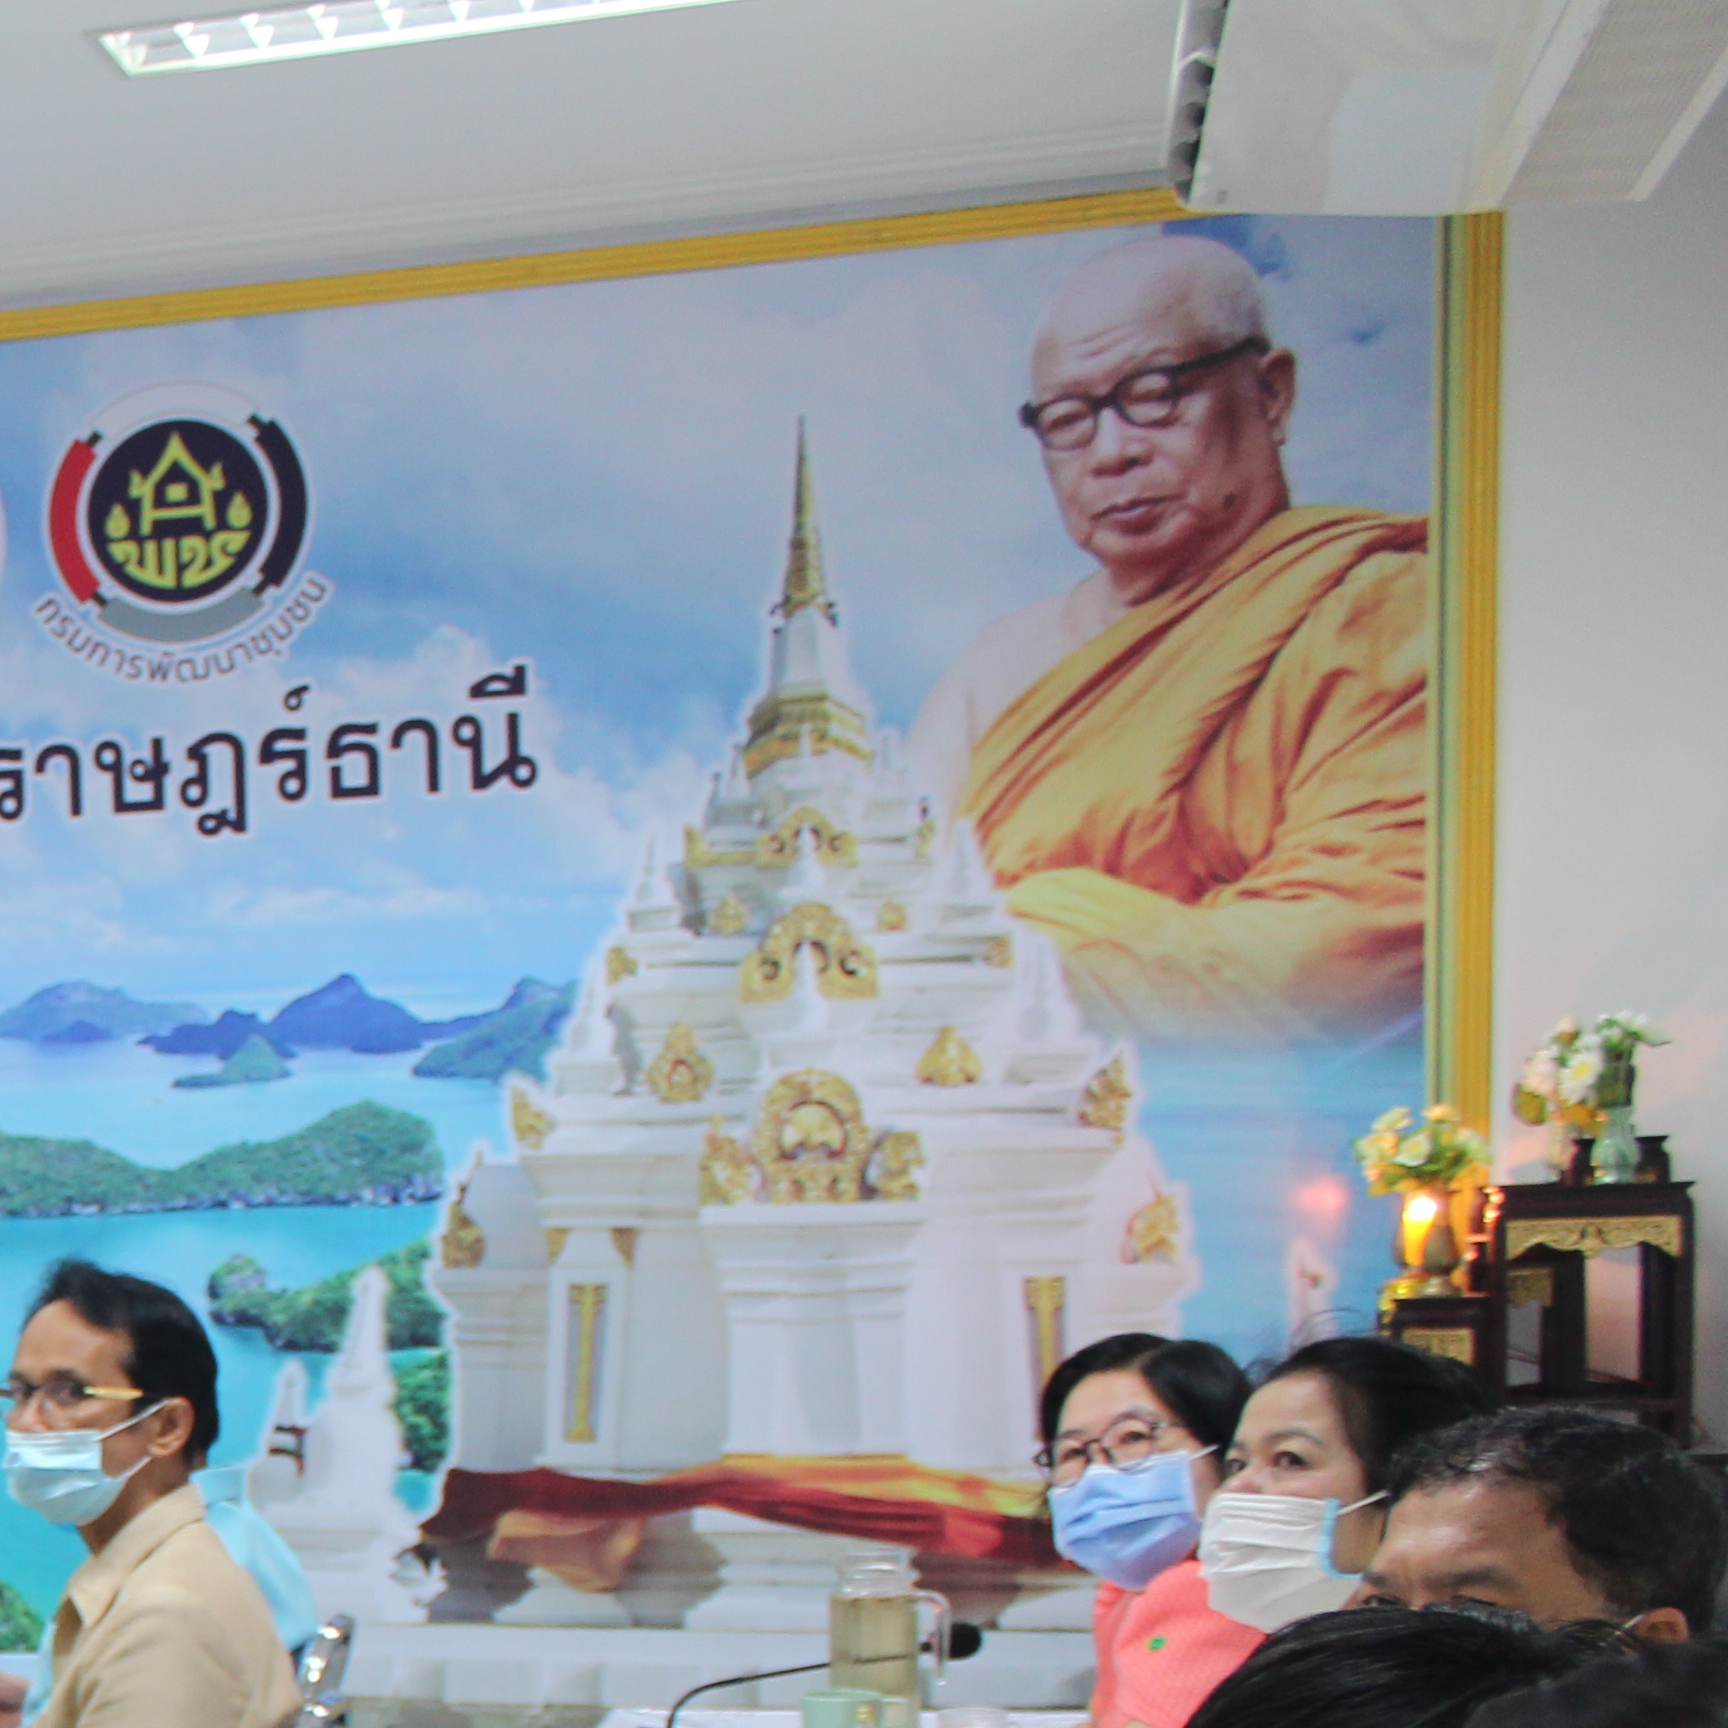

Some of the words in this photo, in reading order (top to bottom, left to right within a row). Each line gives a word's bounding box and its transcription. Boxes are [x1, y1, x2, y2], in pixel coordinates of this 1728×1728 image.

[35, 576, 328, 684] กรมการพัฒนาชุมชน
